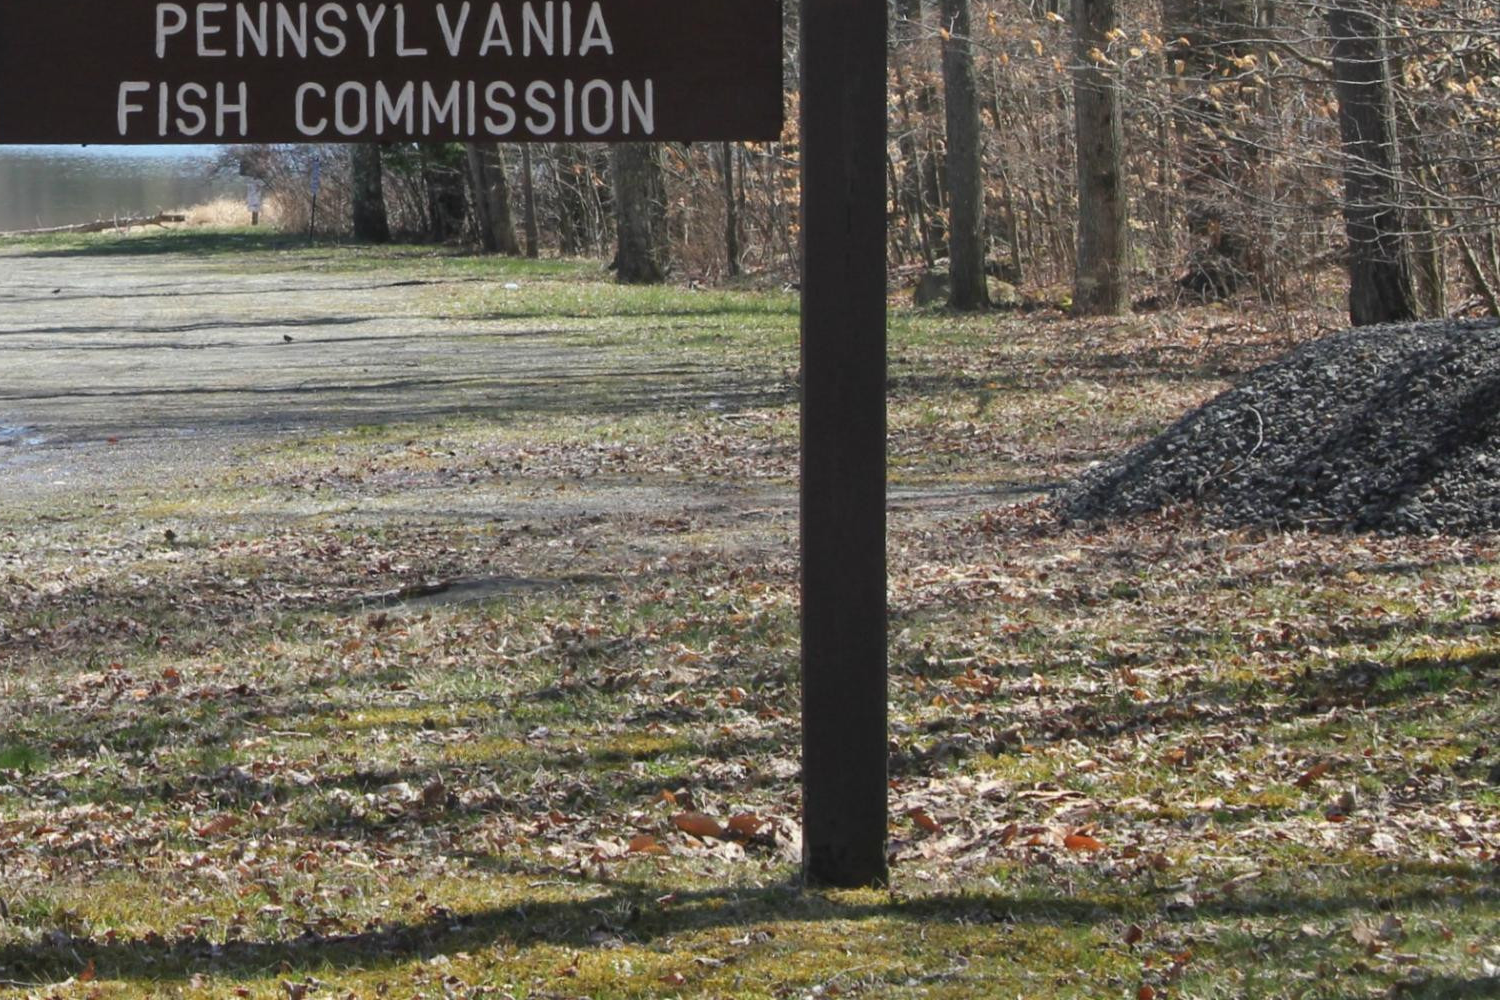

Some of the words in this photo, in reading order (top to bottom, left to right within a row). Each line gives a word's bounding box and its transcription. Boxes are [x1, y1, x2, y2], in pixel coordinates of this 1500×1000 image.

[155, 1, 614, 58] PENNSYLVANIA
[117, 81, 248, 136] FISH
[295, 79, 655, 136] COMMISSION
